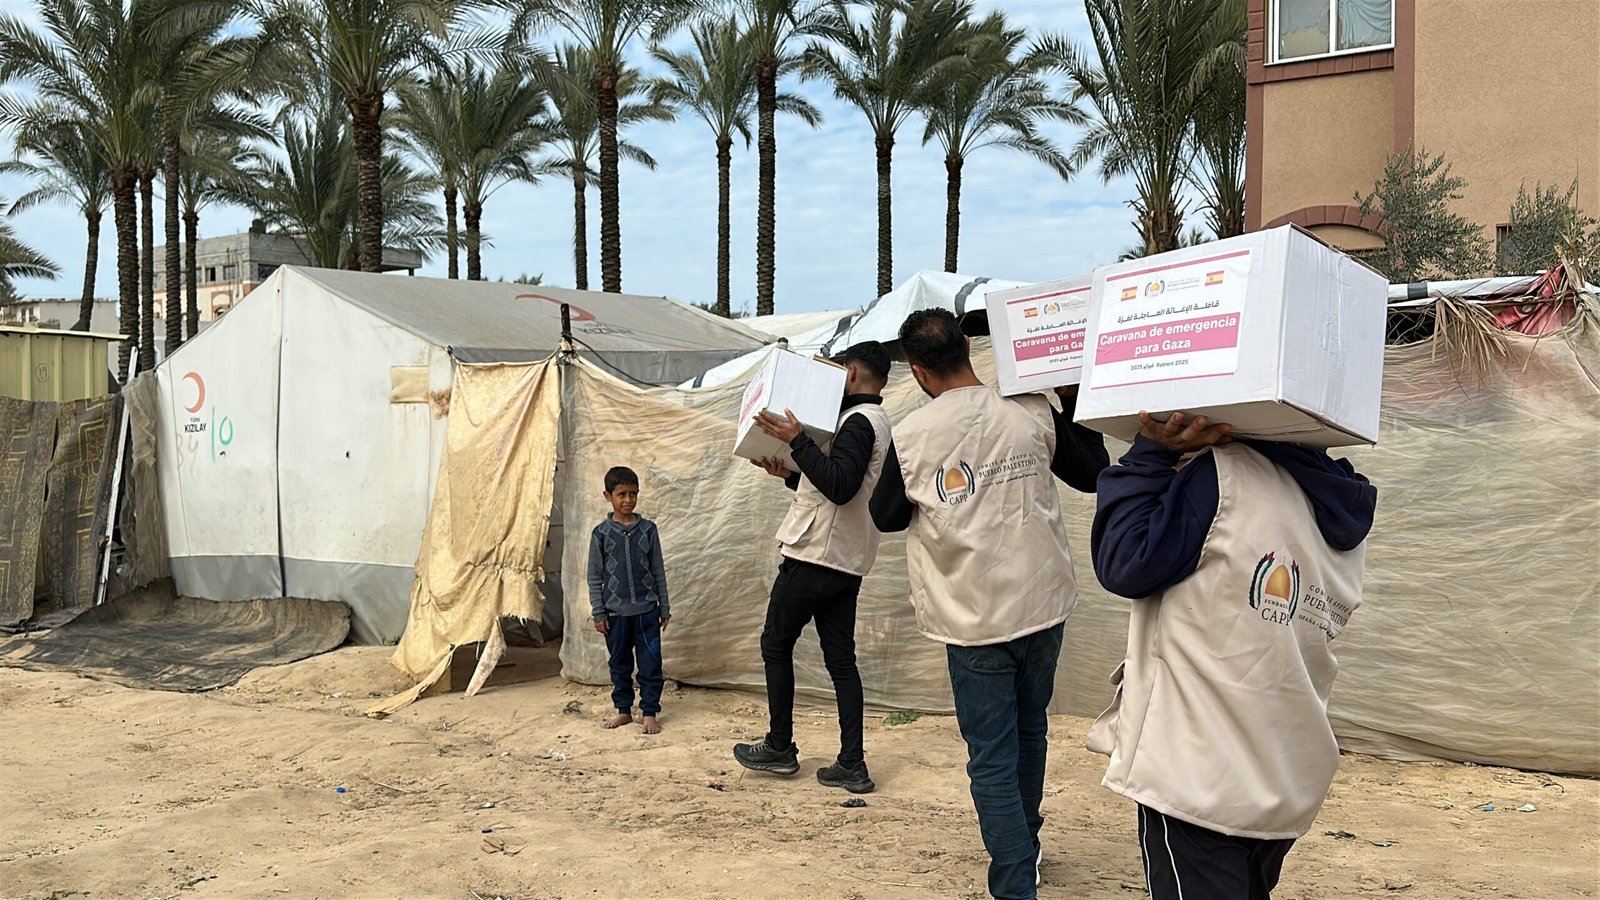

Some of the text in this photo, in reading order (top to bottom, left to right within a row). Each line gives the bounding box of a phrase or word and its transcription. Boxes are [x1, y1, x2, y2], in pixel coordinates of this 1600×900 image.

[1100, 315, 1237, 346] Caravana de emergencia
[1015, 336, 1056, 349] Caravana
[1057, 332, 1069, 341] de
[1049, 341, 1084, 355] para Ga
[1134, 338, 1191, 357] para Gaza
[1009, 453, 1027, 461] APOYO
[978, 466, 1002, 478] PUEBLO
[1003, 458, 1037, 472] PALESTINO
[949, 494, 968, 506] CAPP
